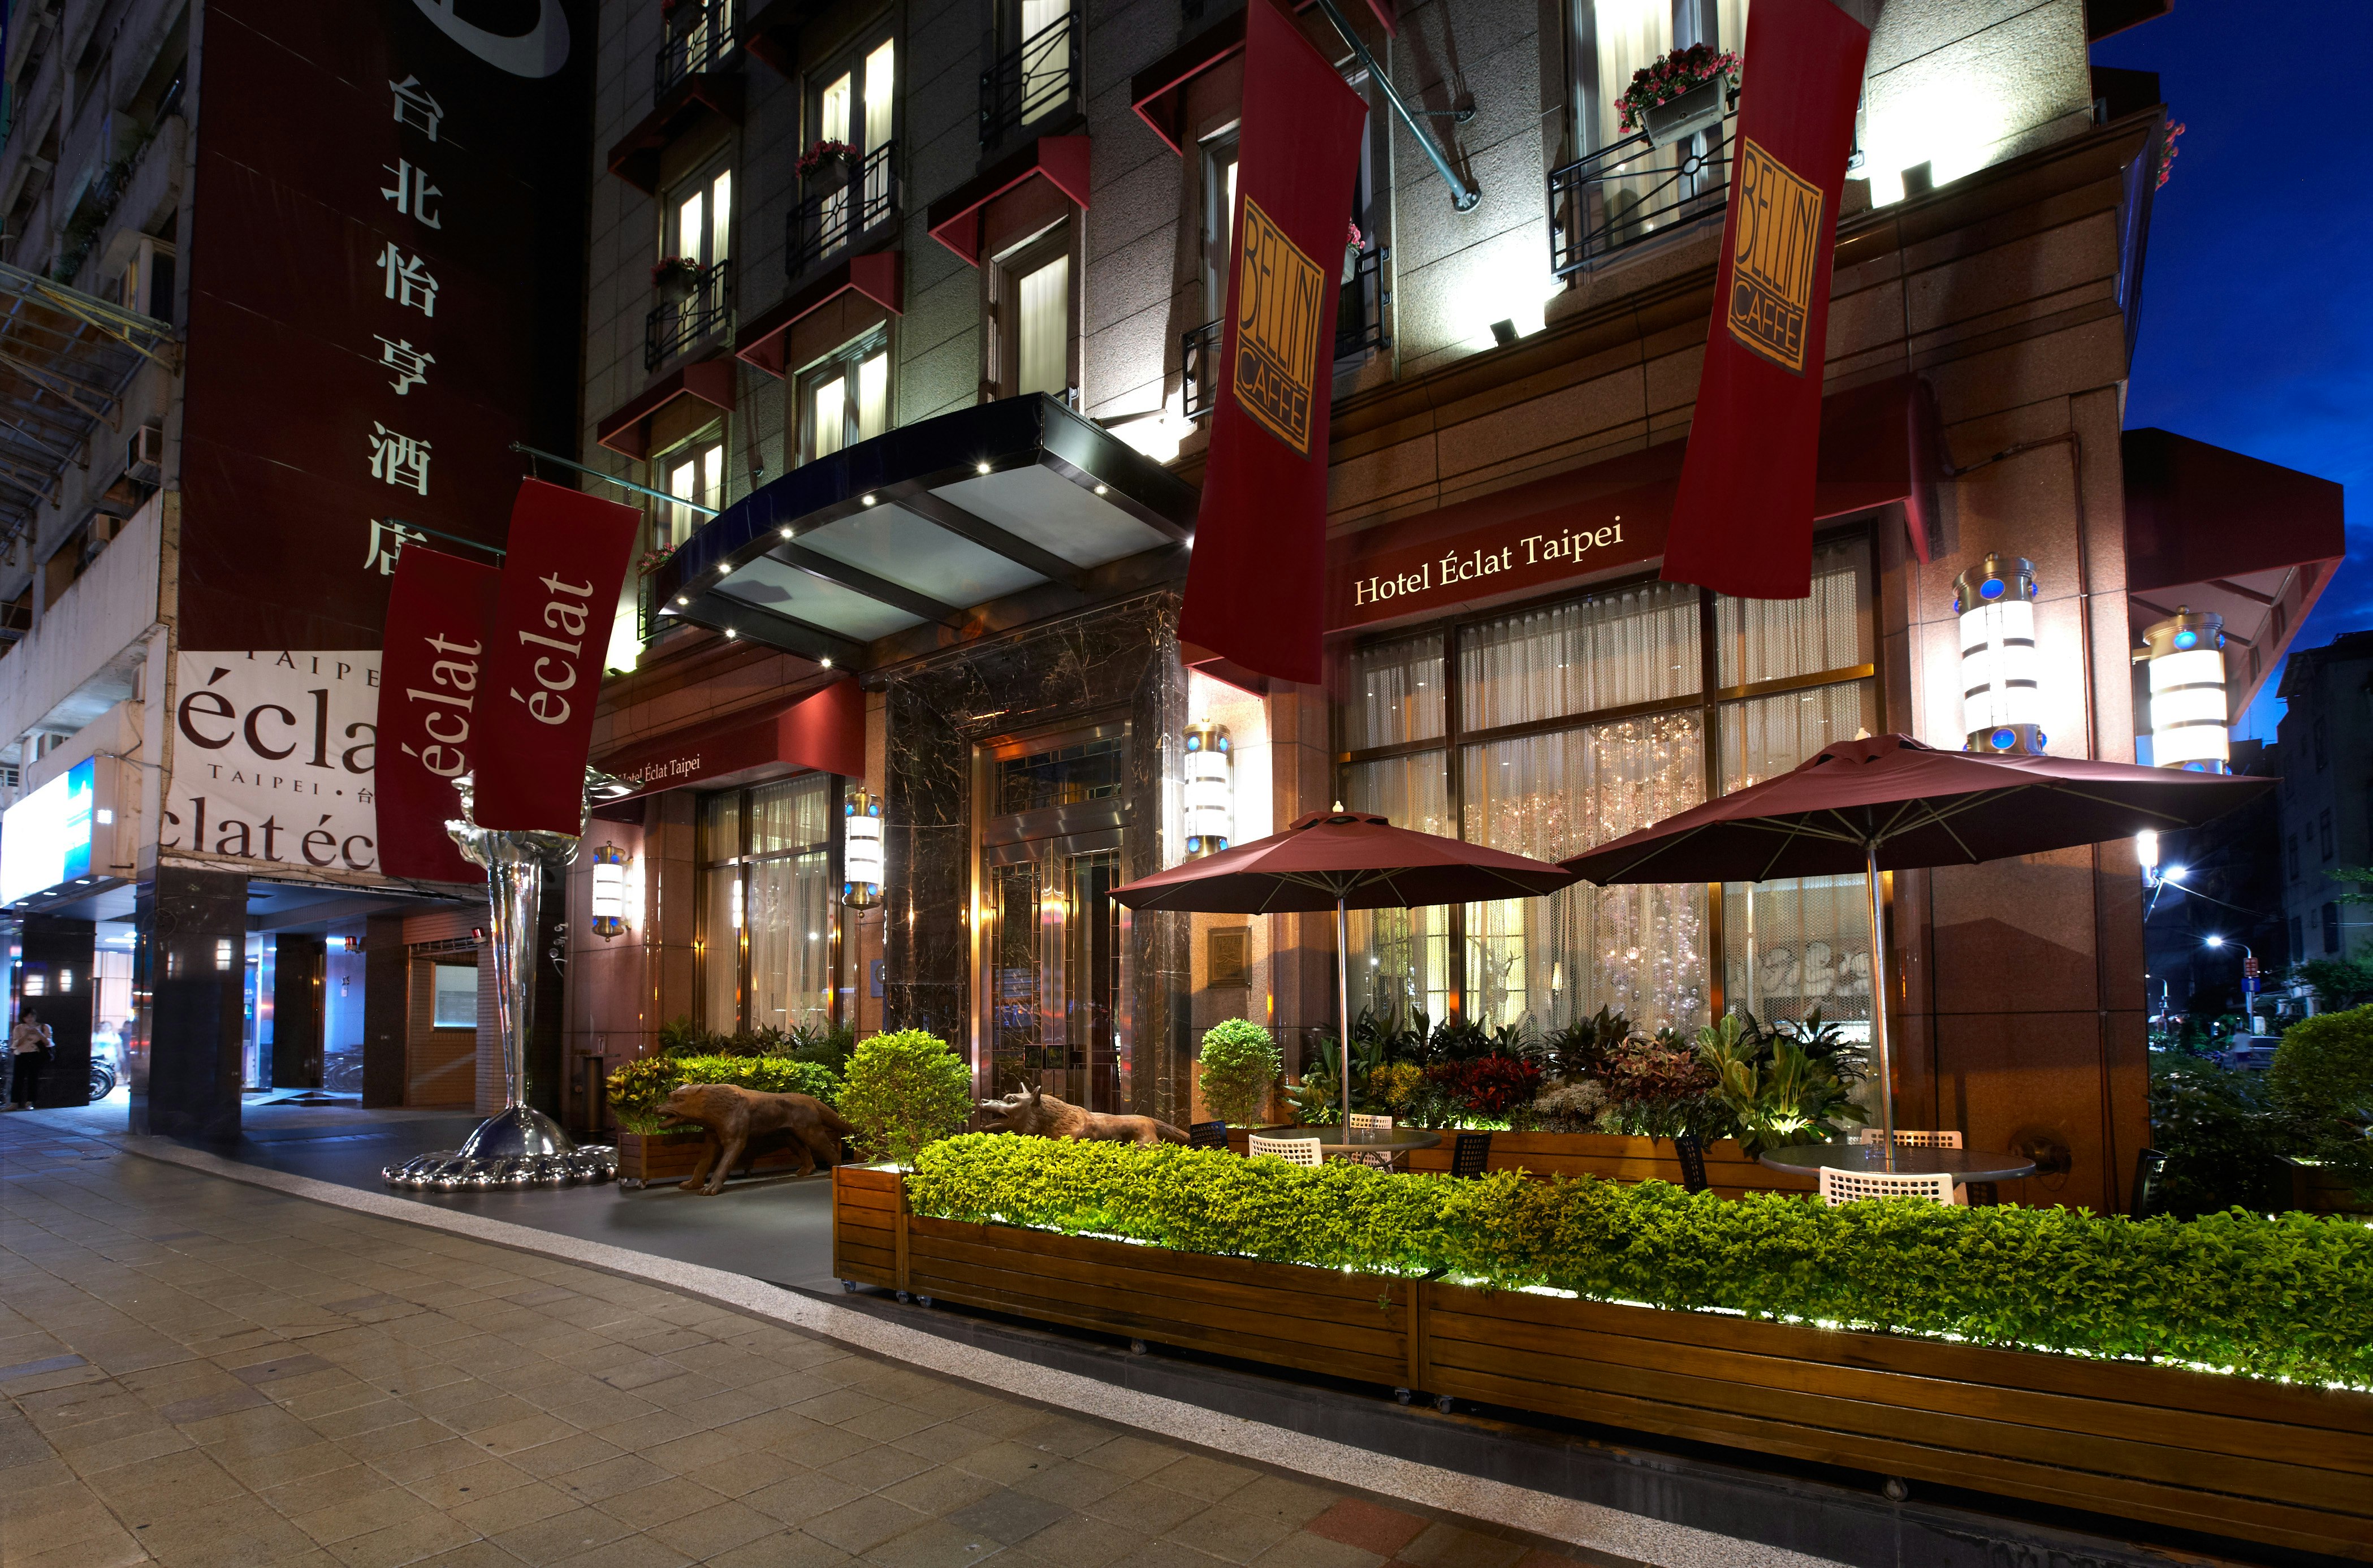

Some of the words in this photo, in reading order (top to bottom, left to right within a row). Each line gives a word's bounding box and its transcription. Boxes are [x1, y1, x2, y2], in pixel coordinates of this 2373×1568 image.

[1240, 207, 1320, 388] BELLINI
[1736, 149, 1818, 306] BELLINI
[1354, 563, 1431, 606] Hotel
[1439, 550, 1512, 585] Éclat
[1520, 515, 1624, 563] Taipei
[401, 633, 482, 777] éclat
[510, 572, 594, 725] éclat
[208, 763, 318, 795] TAIPEI
[645, 762, 668, 781] Éclat
[669, 754, 700, 777] Taipei
